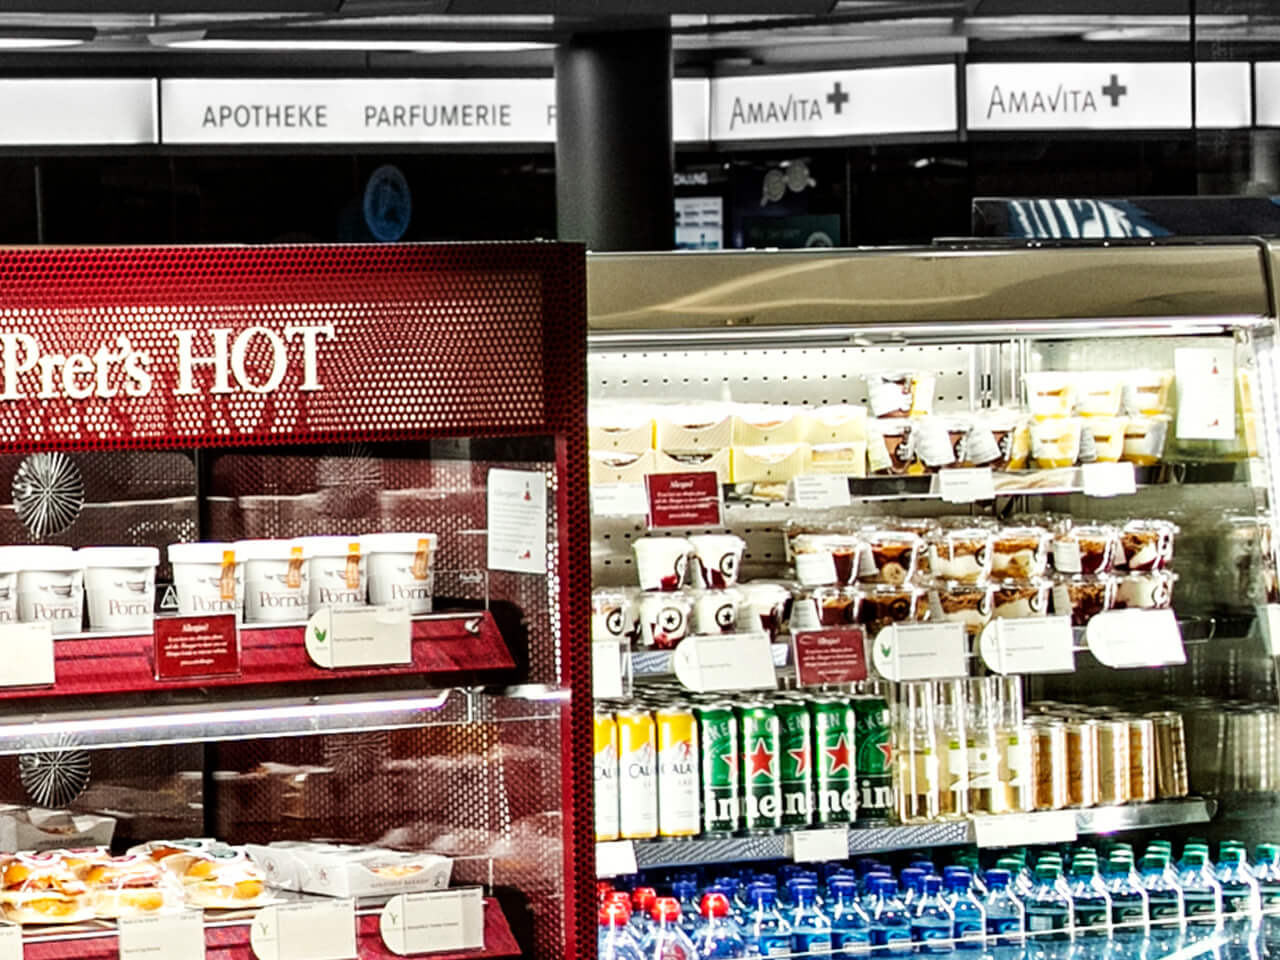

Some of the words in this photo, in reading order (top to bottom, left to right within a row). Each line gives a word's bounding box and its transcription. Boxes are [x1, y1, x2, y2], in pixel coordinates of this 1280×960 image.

[202, 104, 328, 127] APOTHEKE
[364, 104, 511, 127] PARFUMERIE
[173, 324, 335, 396] HOT
